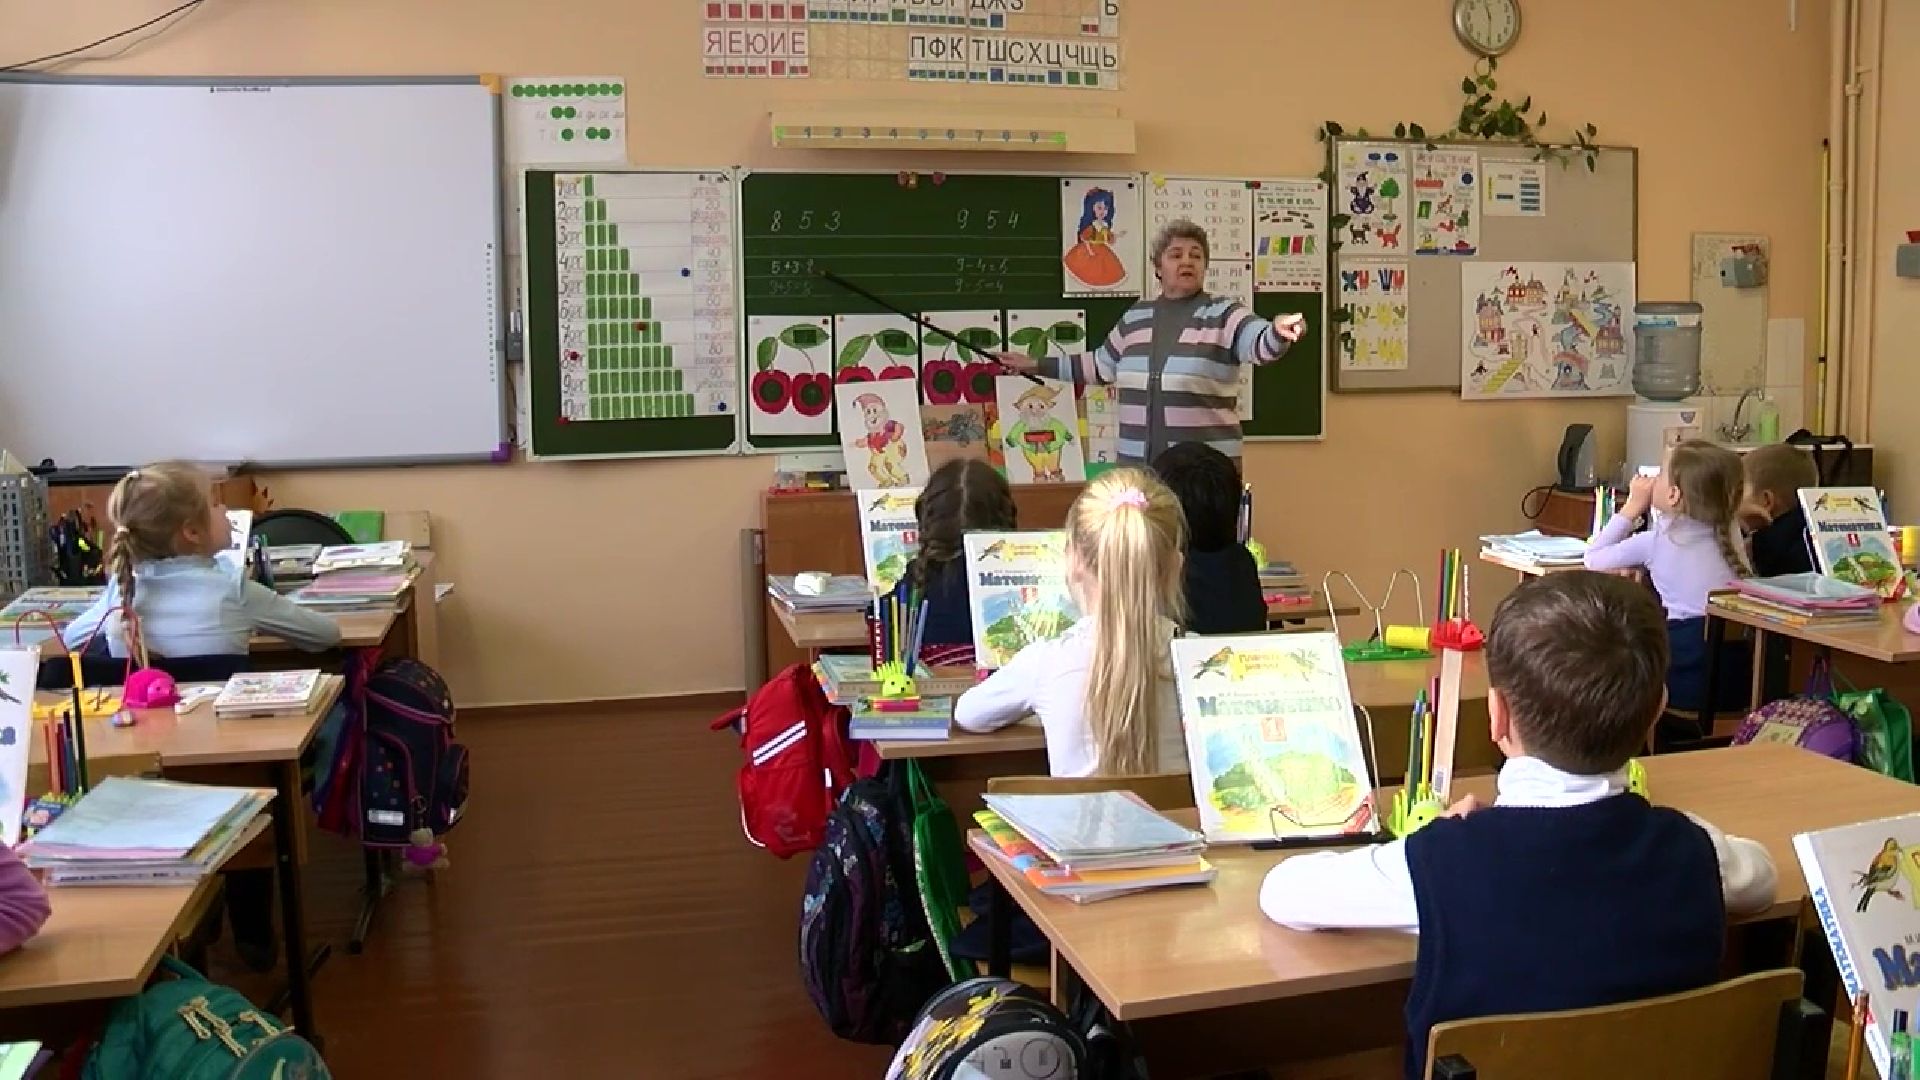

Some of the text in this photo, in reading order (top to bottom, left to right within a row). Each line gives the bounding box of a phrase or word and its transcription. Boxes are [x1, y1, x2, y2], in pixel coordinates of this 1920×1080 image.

[862, 127, 871, 138] 3
[888, 128, 898, 139] 4
[975, 129, 984, 142] 7
[771, 210, 841, 232] 8 5 3
[957, 209, 1020, 230] 9 5 4
[1098, 450, 1107, 464] 5
